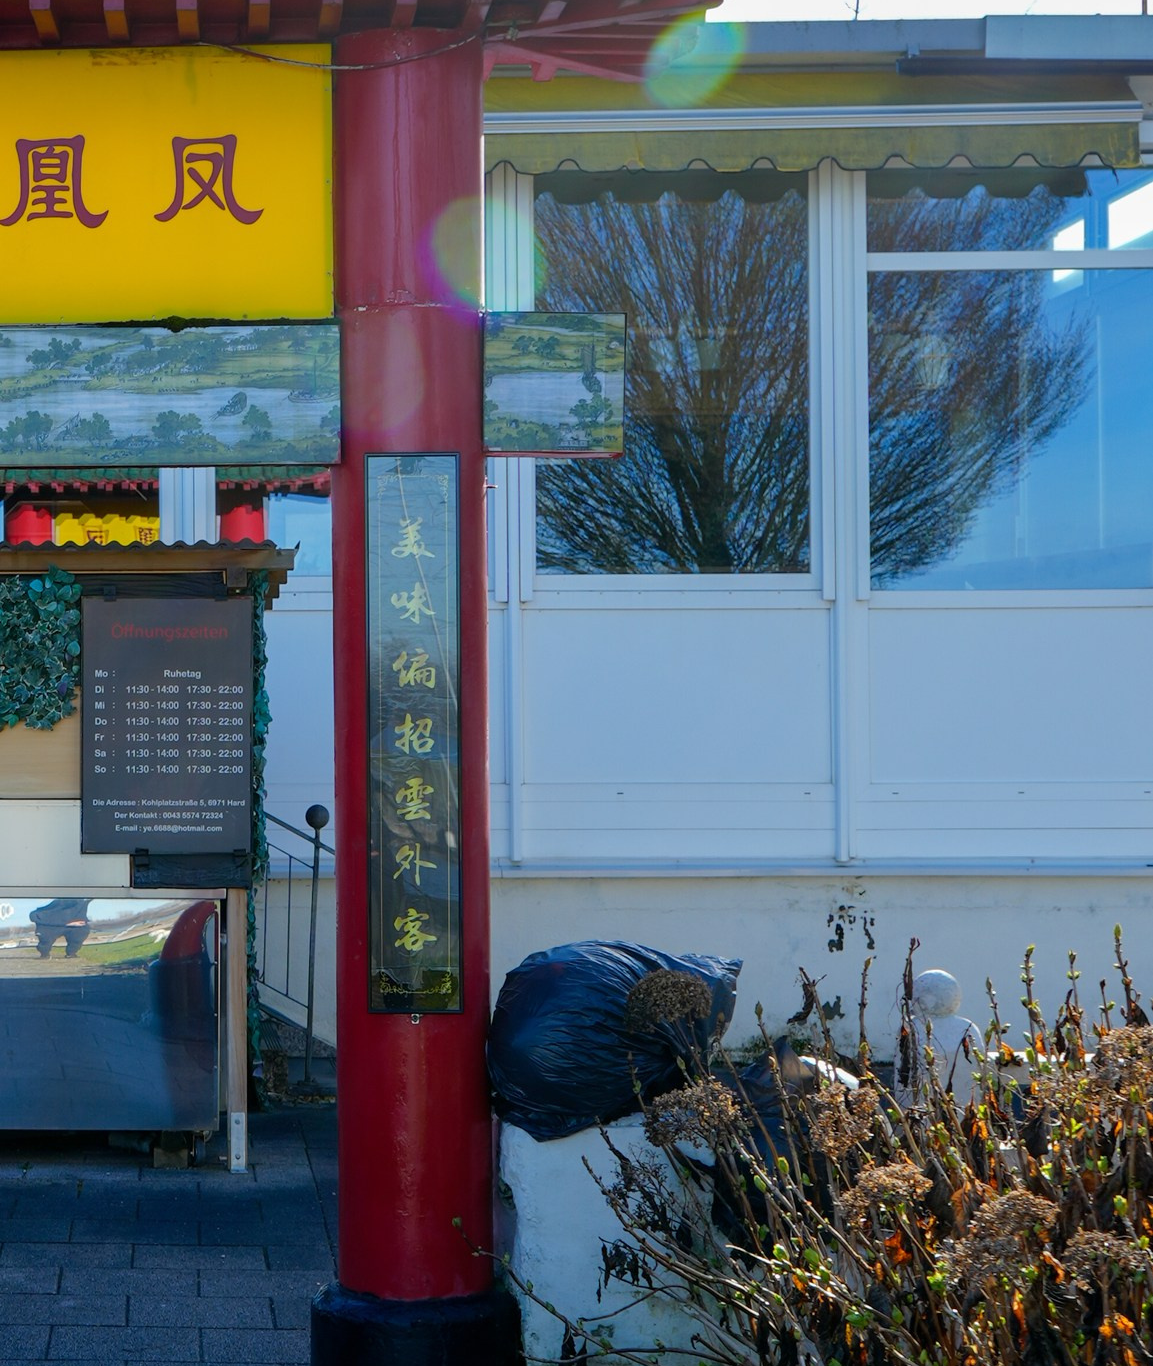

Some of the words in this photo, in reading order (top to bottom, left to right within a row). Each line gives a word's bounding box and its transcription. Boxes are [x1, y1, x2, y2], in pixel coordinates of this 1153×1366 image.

[111, 620, 228, 642] Öffnungszeiten
[163, 670, 202, 679] Ruhetag
[94, 749, 107, 757] Sa
[94, 765, 107, 773] So
